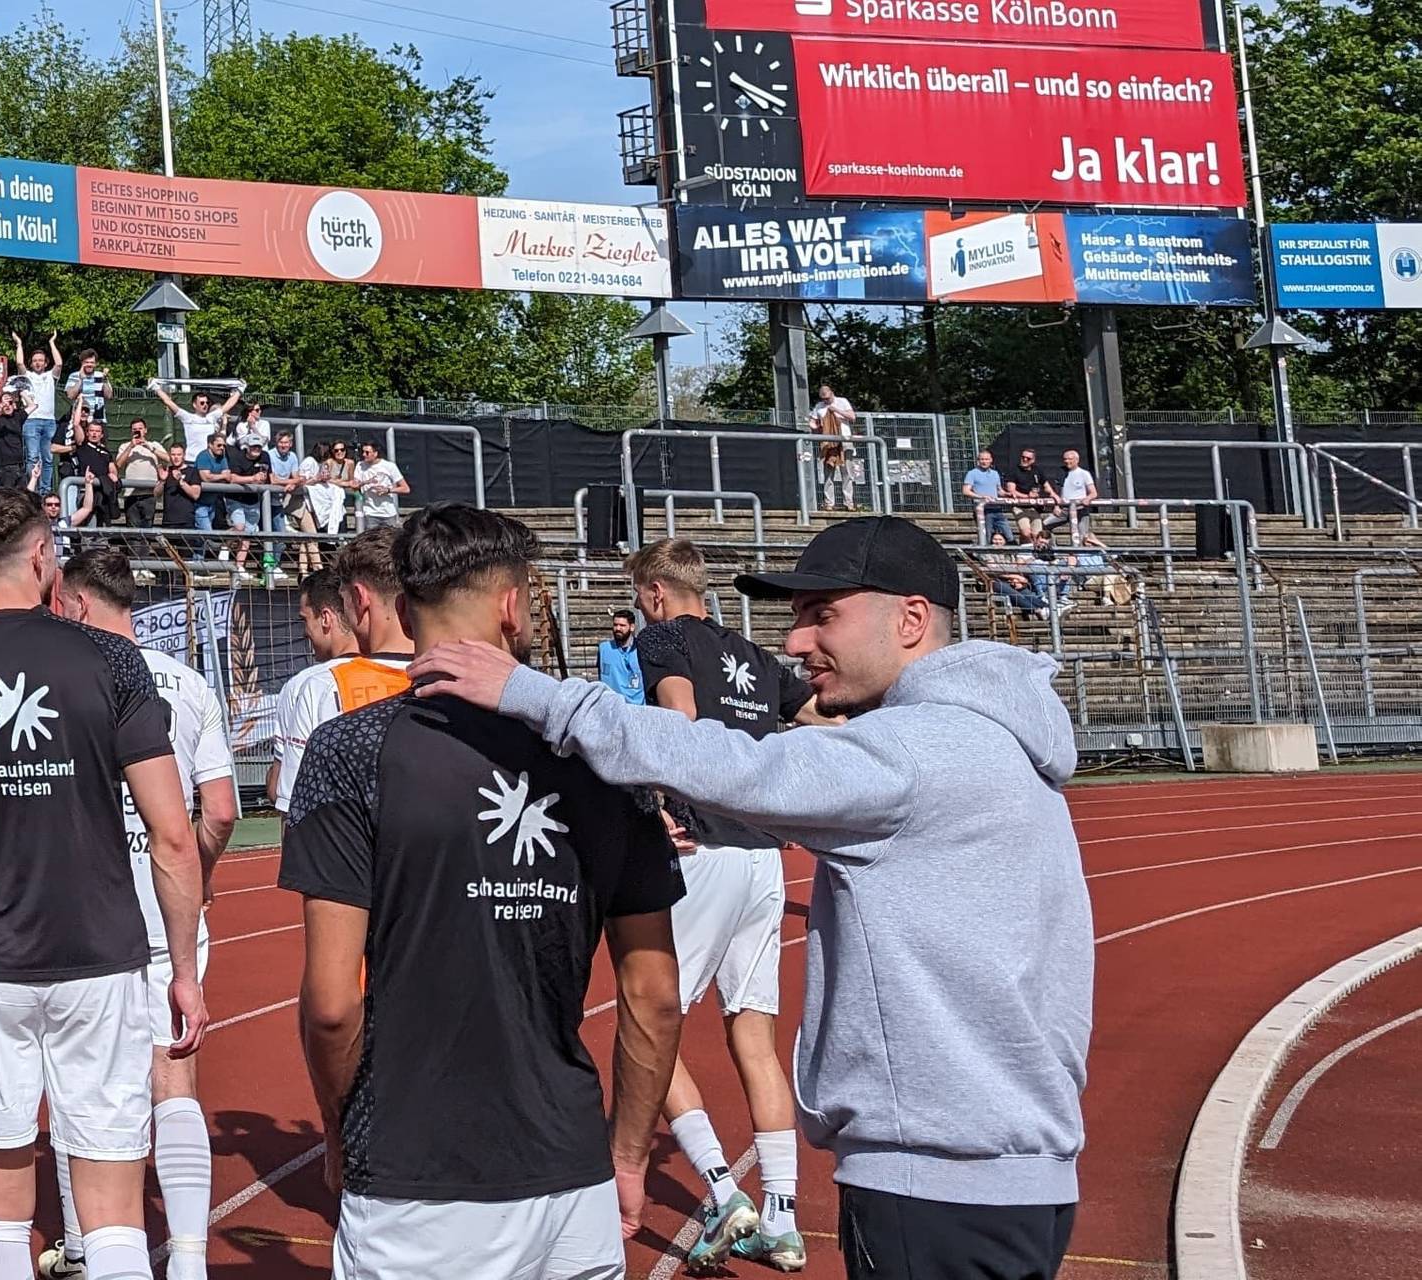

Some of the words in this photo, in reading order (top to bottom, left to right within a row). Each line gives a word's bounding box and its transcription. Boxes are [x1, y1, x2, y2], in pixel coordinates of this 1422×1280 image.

[846, 0, 979, 24] Sparkasse
[991, 0, 1117, 28] KölnBonn
[818, 62, 920, 92] Wirklich
[926, 68, 1008, 94] überall
[1035, 73, 1079, 97] und
[1086, 79, 1111, 98] so
[1117, 76, 1212, 102] einfach?
[827, 162, 964, 179] sparkasse-koelnbonn.de
[1051, 136, 1101, 183] Ja
[1114, 137, 1220, 186] klar!
[704, 163, 796, 182] SÜDSTADION
[10, 176, 54, 203] deine
[91, 181, 133, 197] ECHTES
[135, 186, 199, 203] SHOPPING
[732, 180, 771, 197] KÖLN
[92, 200, 143, 217] BEGINNT
[146, 206, 167, 219] MIT
[169, 208, 190, 222] 150
[194, 210, 238, 225] SHOPS
[483, 207, 526, 220] HEIZUNG
[534, 210, 575, 223] SANITÄR
[583, 214, 663, 229] MEISTERBETRIEB
[17, 214, 58, 244] Köln!
[92, 218, 117, 233] UND
[119, 221, 206, 240] KOSTENLOSEN
[320, 216, 366, 236] hürth
[693, 222, 781, 250] ALLES
[788, 216, 846, 242] WAT
[93, 238, 177, 257] PARKPLÄTZEN!
[333, 231, 373, 252] park
[493, 229, 575, 258] Markus
[582, 232, 658, 266] Ziegler
[968, 240, 1014, 261] MYLIUS
[1081, 233, 1120, 246] Haus-
[1125, 234, 1135, 247] &
[1138, 234, 1203, 248] Baustrom
[1278, 239, 1296, 249] IHR
[1297, 240, 1348, 250] SPEZIALIST
[1350, 237, 1370, 249] FÜR
[741, 244, 789, 272] IHR
[795, 239, 872, 266] VOLT!
[969, 253, 1015, 271] INNOVATION
[1083, 251, 1153, 266] Gebäude-,
[1155, 252, 1238, 266] Sicherheits-
[1280, 254, 1372, 266] STAHLLOGISTIK
[512, 268, 555, 283] Telefon
[558, 271, 642, 287] 0221-9434684
[722, 262, 909, 289] www.mylius-innovation.de
[1085, 268, 1210, 283] Multimediatechnik
[1282, 284, 1375, 293] WWW.STAHLSPEDITION.DE
[720, 696, 769, 713] schauinsland
[0, 779, 51, 797] reisen
[466, 876, 579, 904] schauinsland
[494, 901, 543, 920] reisen
